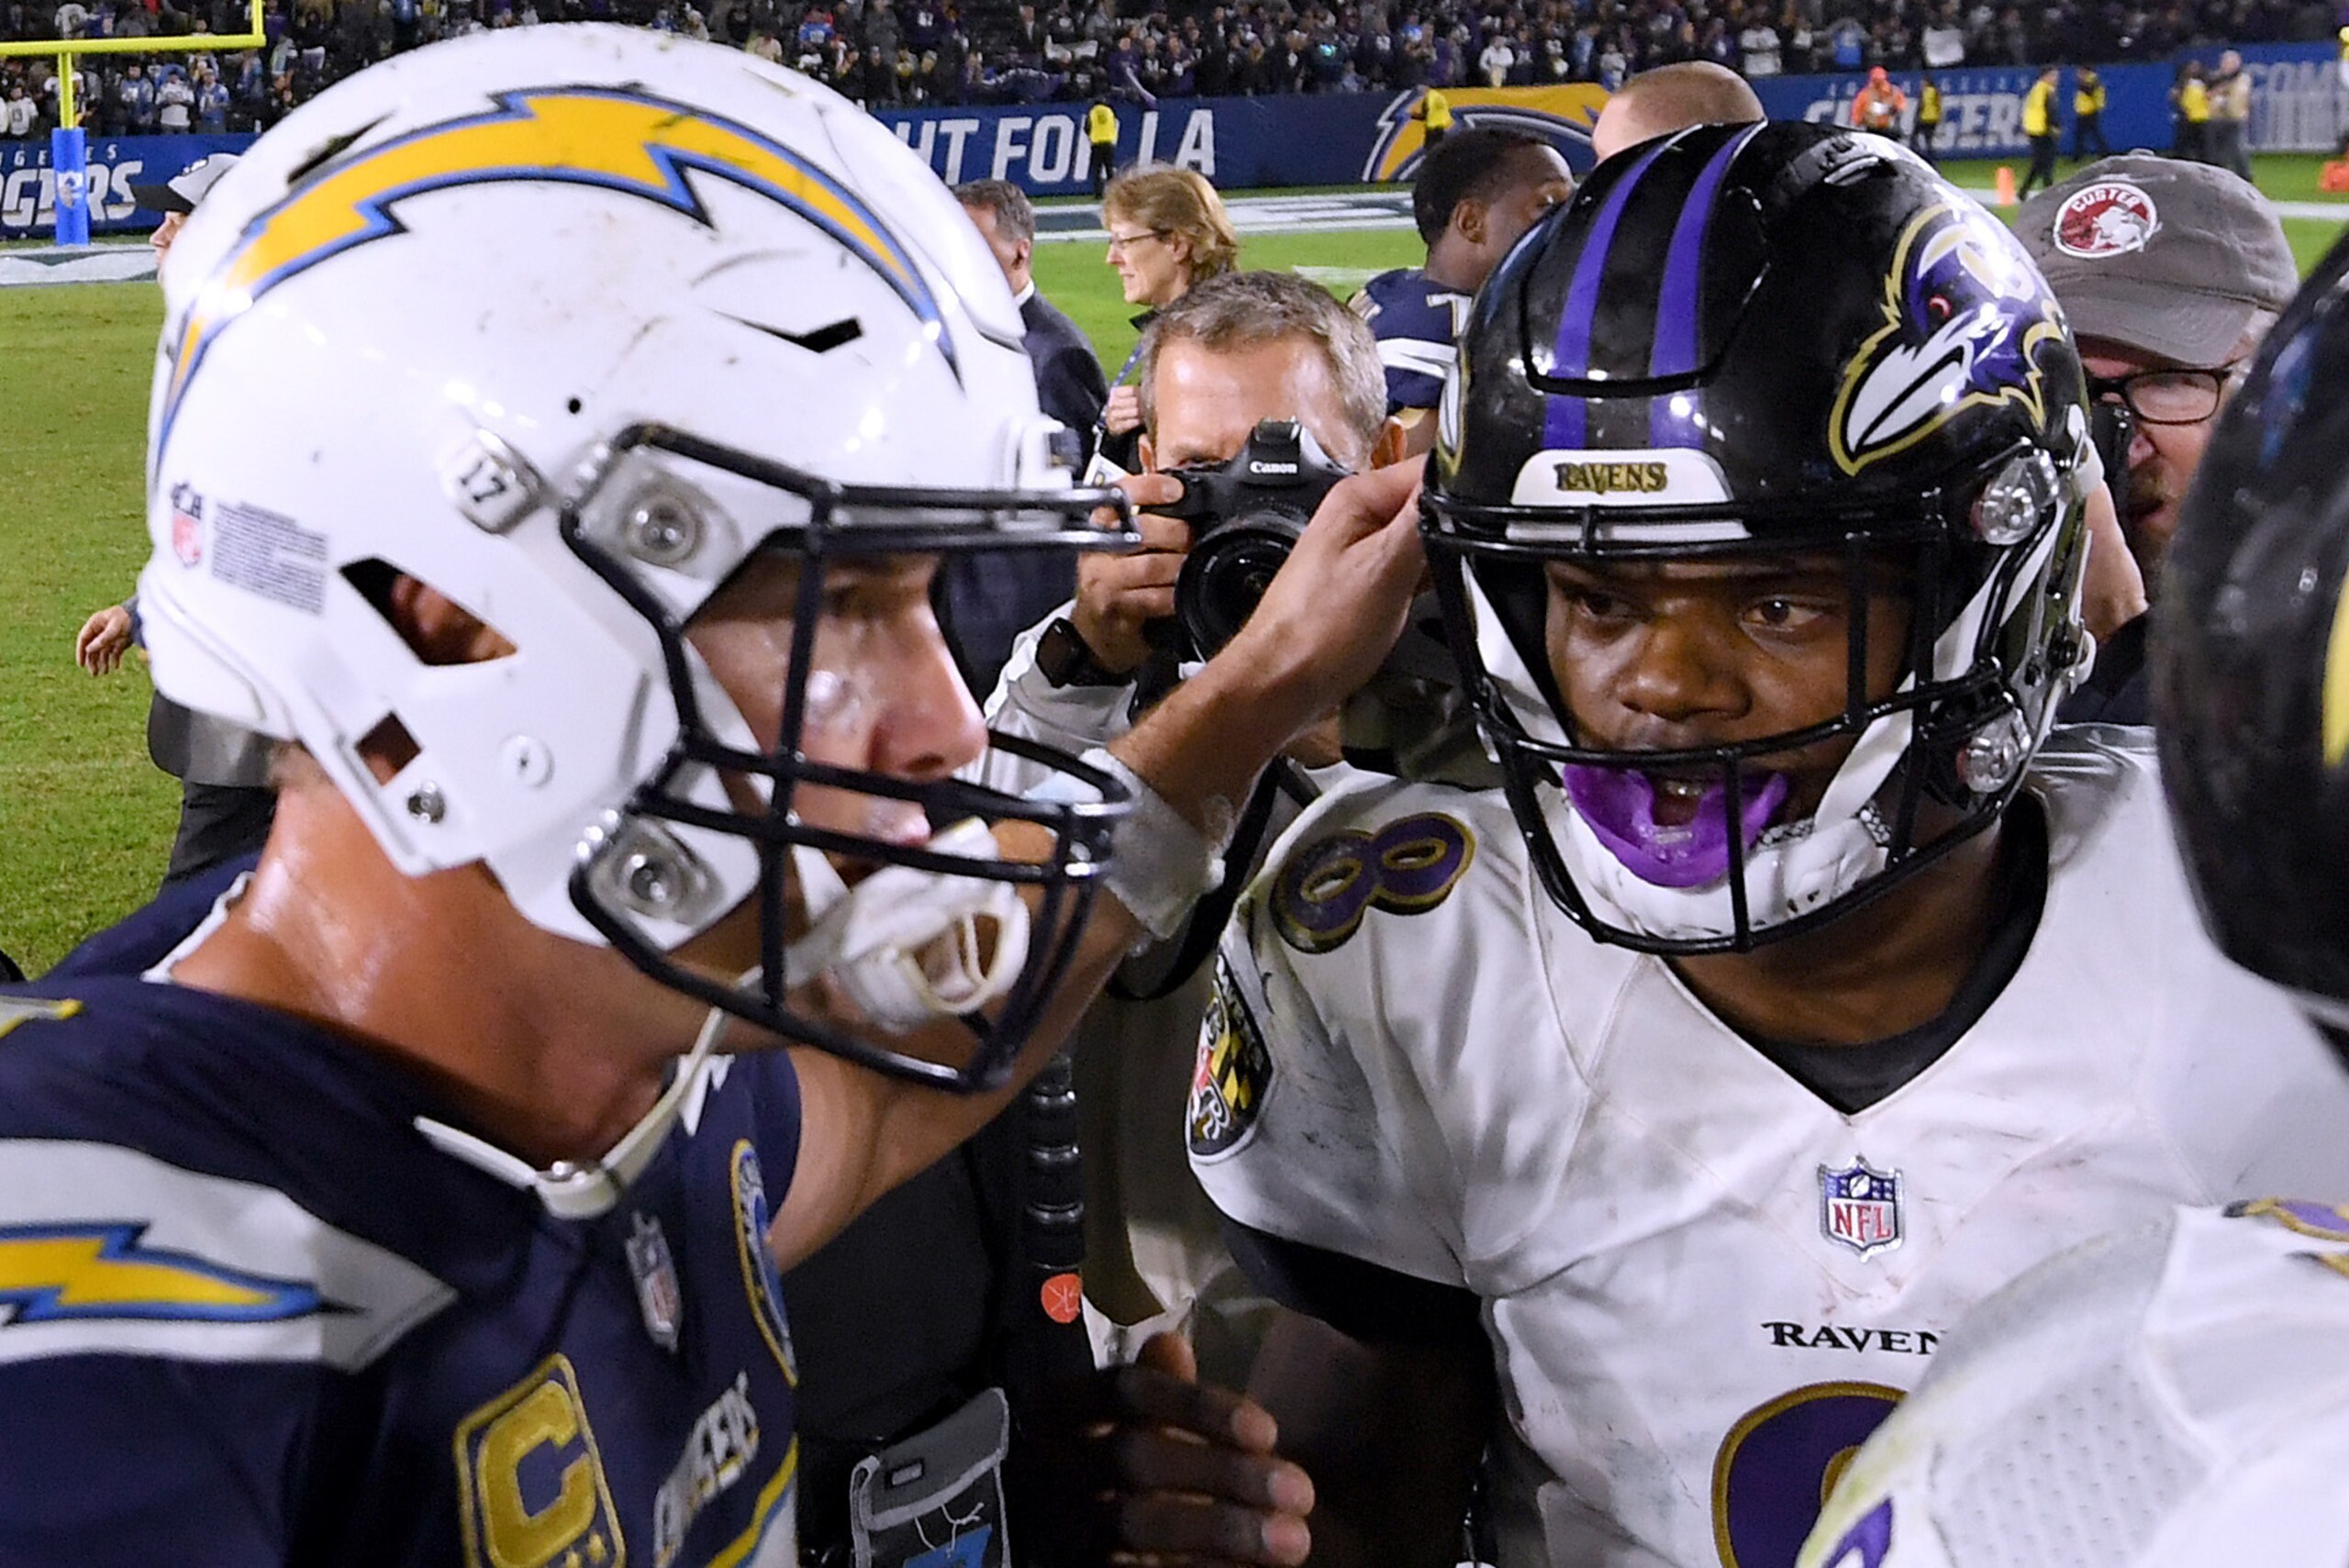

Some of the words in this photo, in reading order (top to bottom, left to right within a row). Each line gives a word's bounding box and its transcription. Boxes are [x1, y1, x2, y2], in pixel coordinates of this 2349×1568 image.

[0, 160, 143, 228] GERS
[2070, 187, 2143, 213] CUSTER
[460, 461, 507, 504] 17
[1250, 461, 1297, 474] Canon
[1553, 462, 1668, 494] RAVENS
[1833, 1202, 1892, 1242] NFL
[476, 1379, 596, 1568] C
